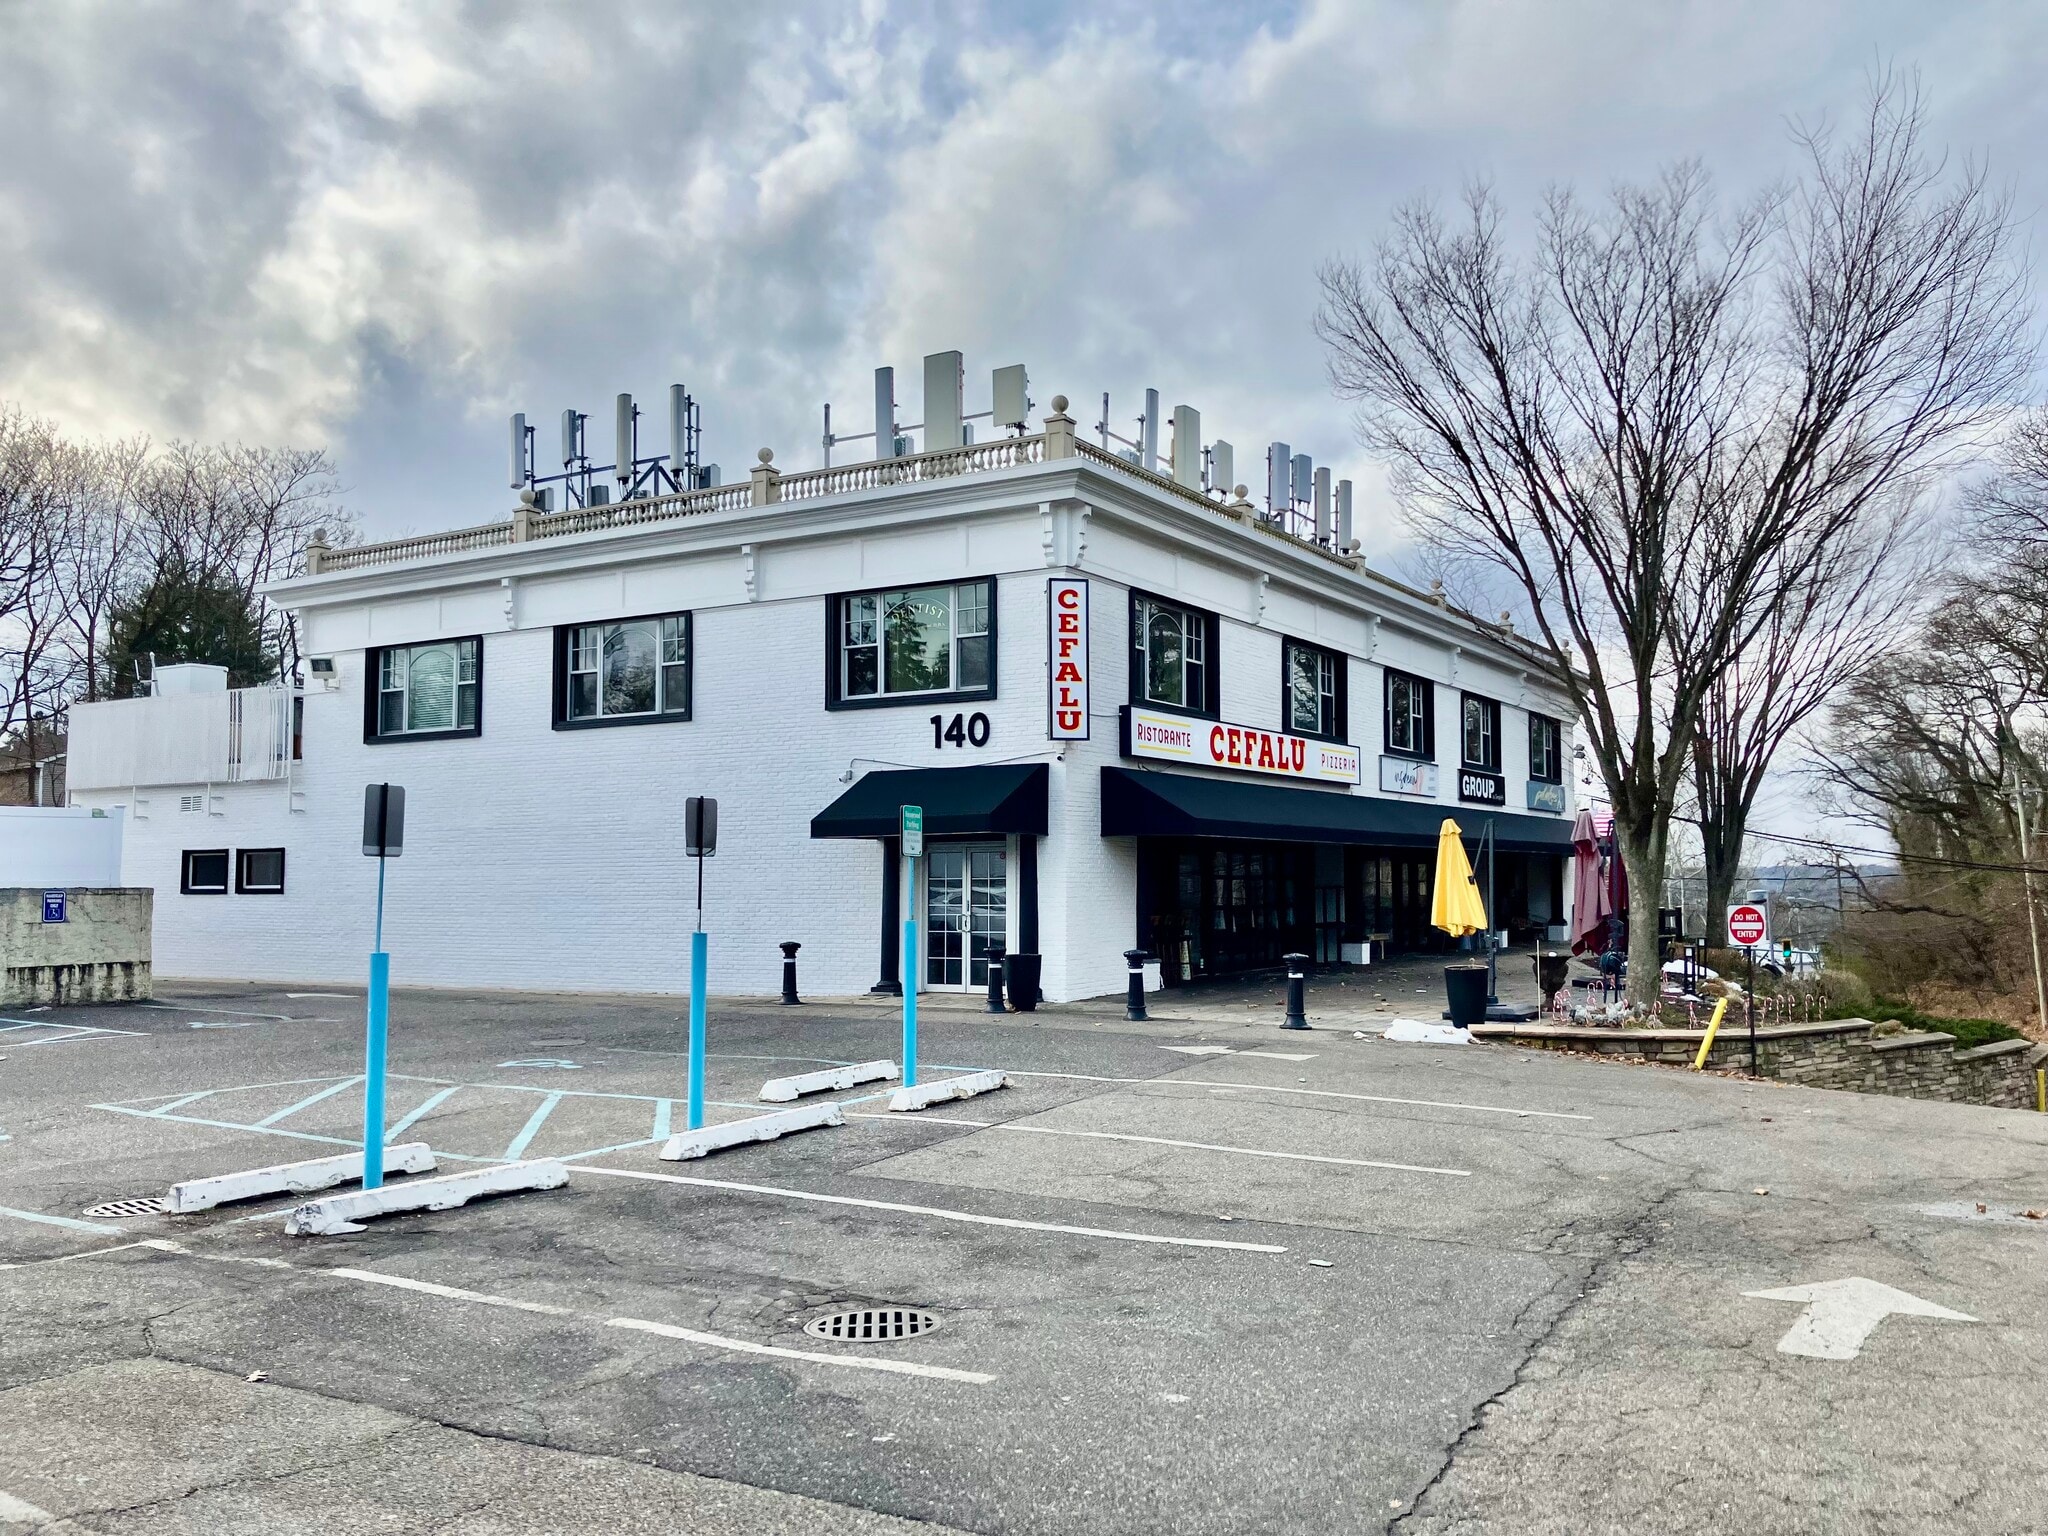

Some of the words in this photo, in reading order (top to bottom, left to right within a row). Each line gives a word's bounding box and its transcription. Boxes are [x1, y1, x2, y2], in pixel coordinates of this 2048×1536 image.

[891, 603, 945, 623] DENTIST
[1055, 589, 1083, 732] CEFALU
[929, 711, 991, 749] 140
[1137, 722, 1192, 748] RISTORANTE
[1209, 725, 1306, 772] CEFALU
[1321, 753, 1357, 772] PIZZERIA
[1462, 774, 1495, 799] GROUP
[1734, 913, 1744, 921] DO
[1745, 913, 1759, 921] NOT
[1736, 930, 1758, 938] ENTER
